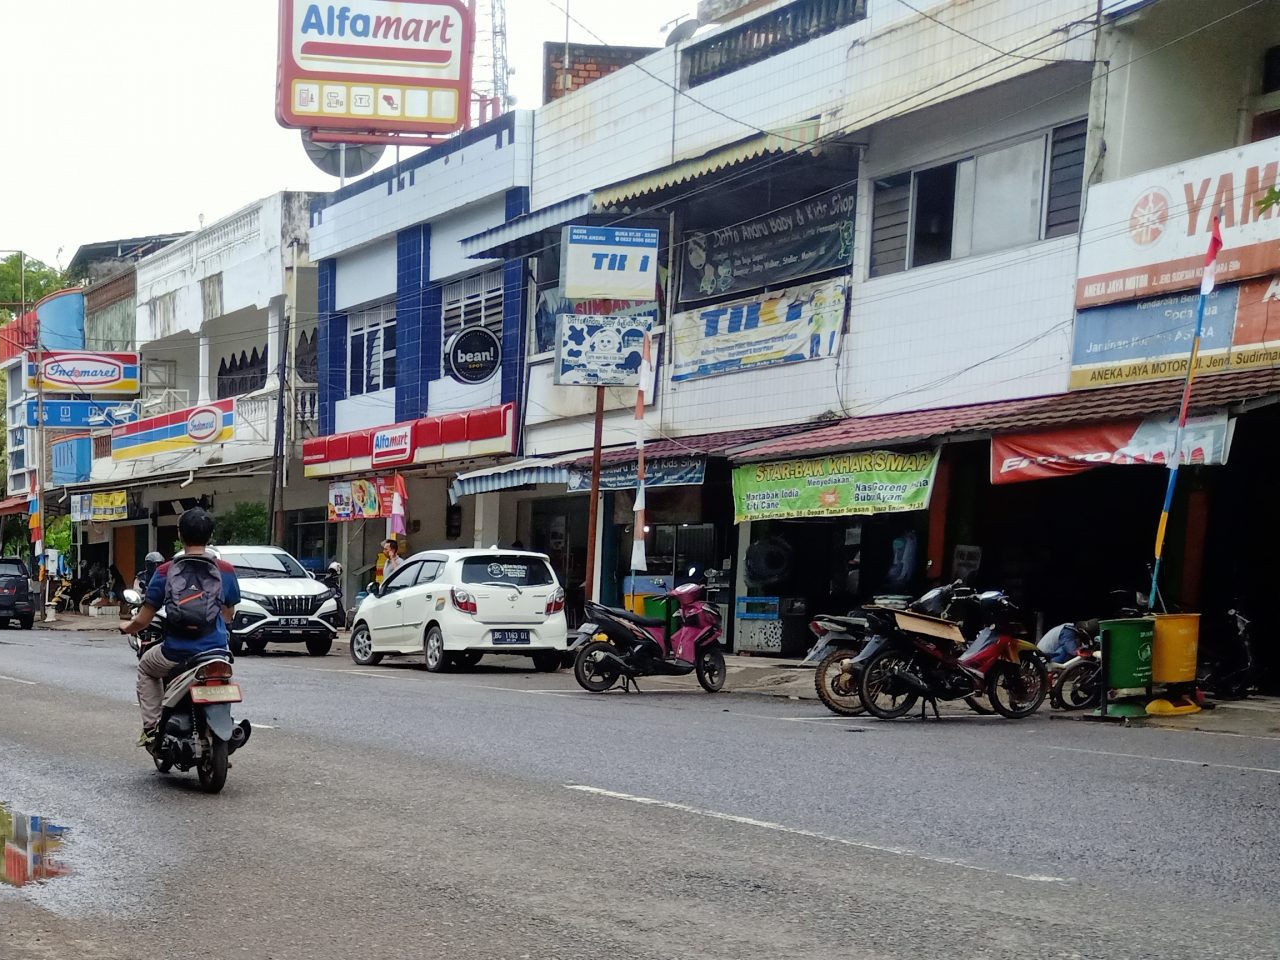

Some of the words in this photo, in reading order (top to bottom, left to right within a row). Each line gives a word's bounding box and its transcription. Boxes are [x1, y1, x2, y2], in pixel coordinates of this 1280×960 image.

[301, 4, 455, 43] Alfamart
[830, 194, 854, 217] Shop
[1184, 161, 1280, 237] YAM
[1083, 281, 1106, 298] ANEKA
[1107, 278, 1124, 294] JAYA
[457, 346, 494, 363] bean!
[48, 364, 117, 378] Indomaret
[1090, 367, 1123, 382] ANEKA
[1125, 364, 1149, 378] JAYA
[1151, 359, 1188, 374] MOTOR
[1207, 353, 1233, 369] Jend.
[375, 432, 408, 449] Alfamart
[756, 462, 825, 483] STAR-BAK
[807, 476, 850, 488] Menyediakan
[494, 631, 502, 639] BG
